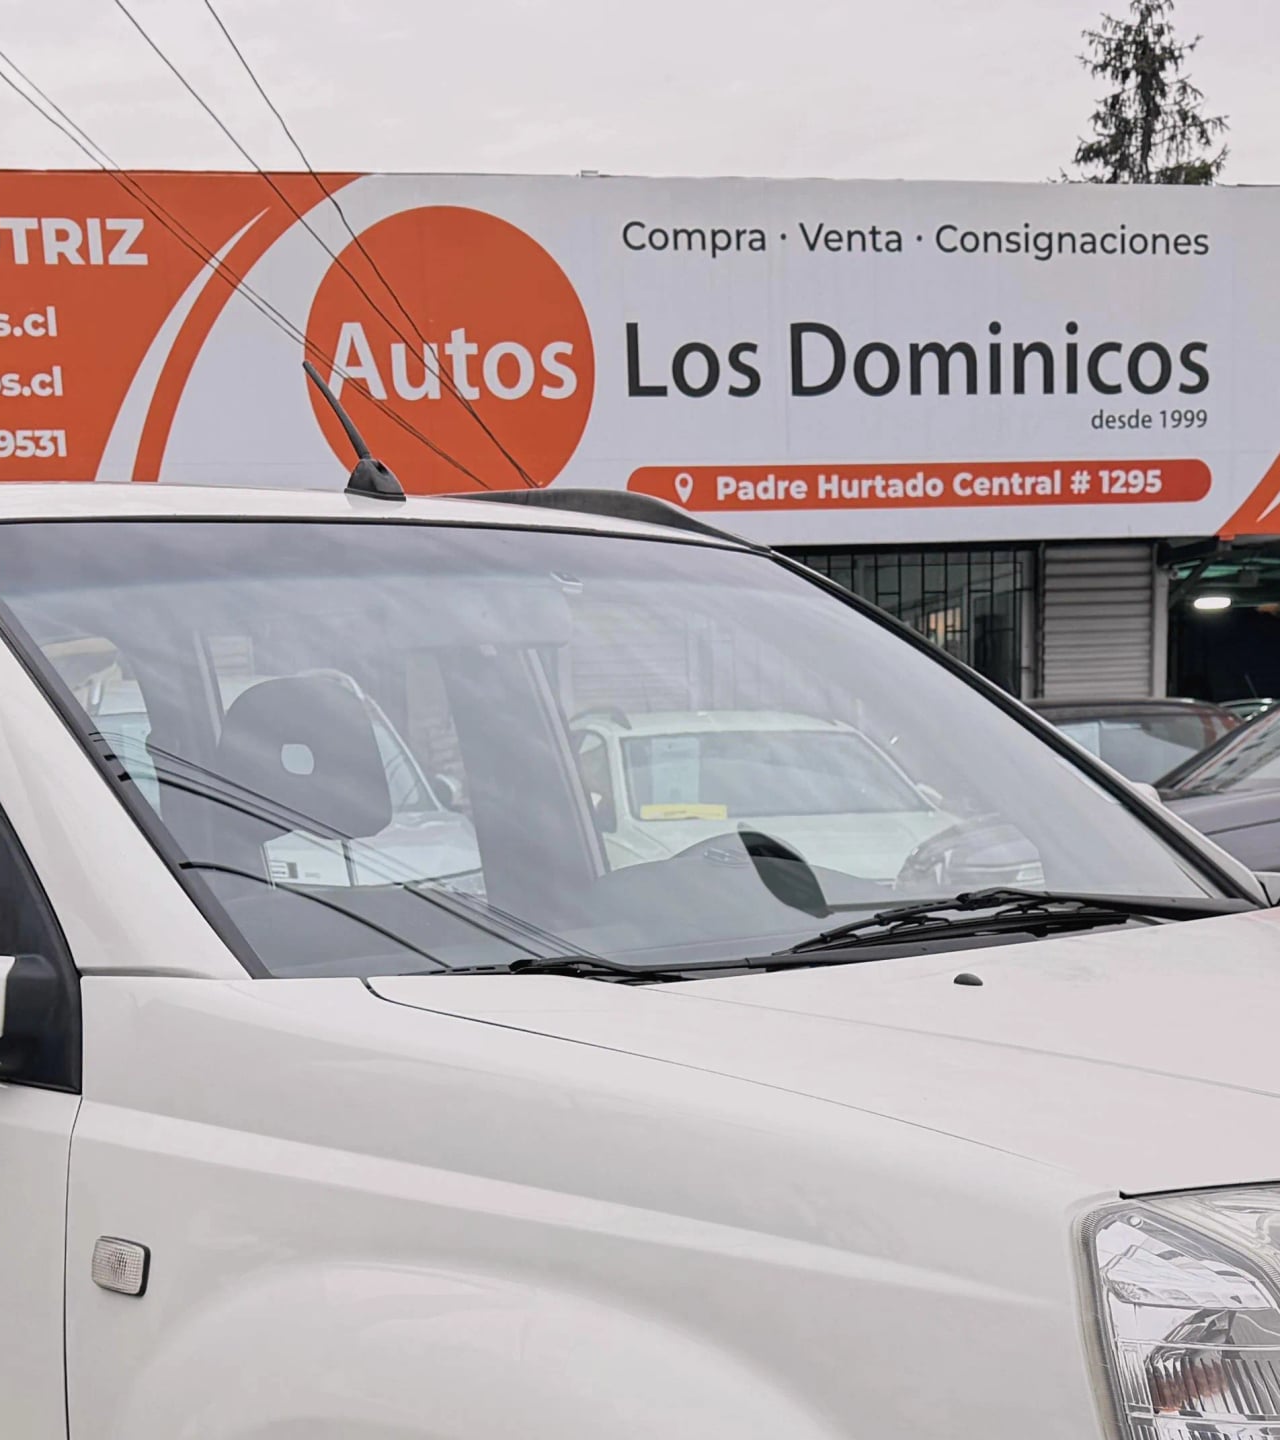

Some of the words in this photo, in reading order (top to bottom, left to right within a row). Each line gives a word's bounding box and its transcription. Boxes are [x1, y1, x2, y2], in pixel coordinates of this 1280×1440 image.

[622, 220, 767, 259] Compra
[798, 222, 903, 253] Venta
[935, 222, 1210, 262] Consignaciones
[328, 321, 578, 401] Autos
[625, 322, 762, 399] Los
[790, 320, 1210, 396] Dominicos
[1091, 408, 1153, 430] desde
[1159, 409, 1208, 430] 1999
[716, 474, 808, 501] Padre
[818, 472, 944, 500] Hurtado
[952, 469, 1061, 497] Central
[1098, 469, 1163, 494] 1295
